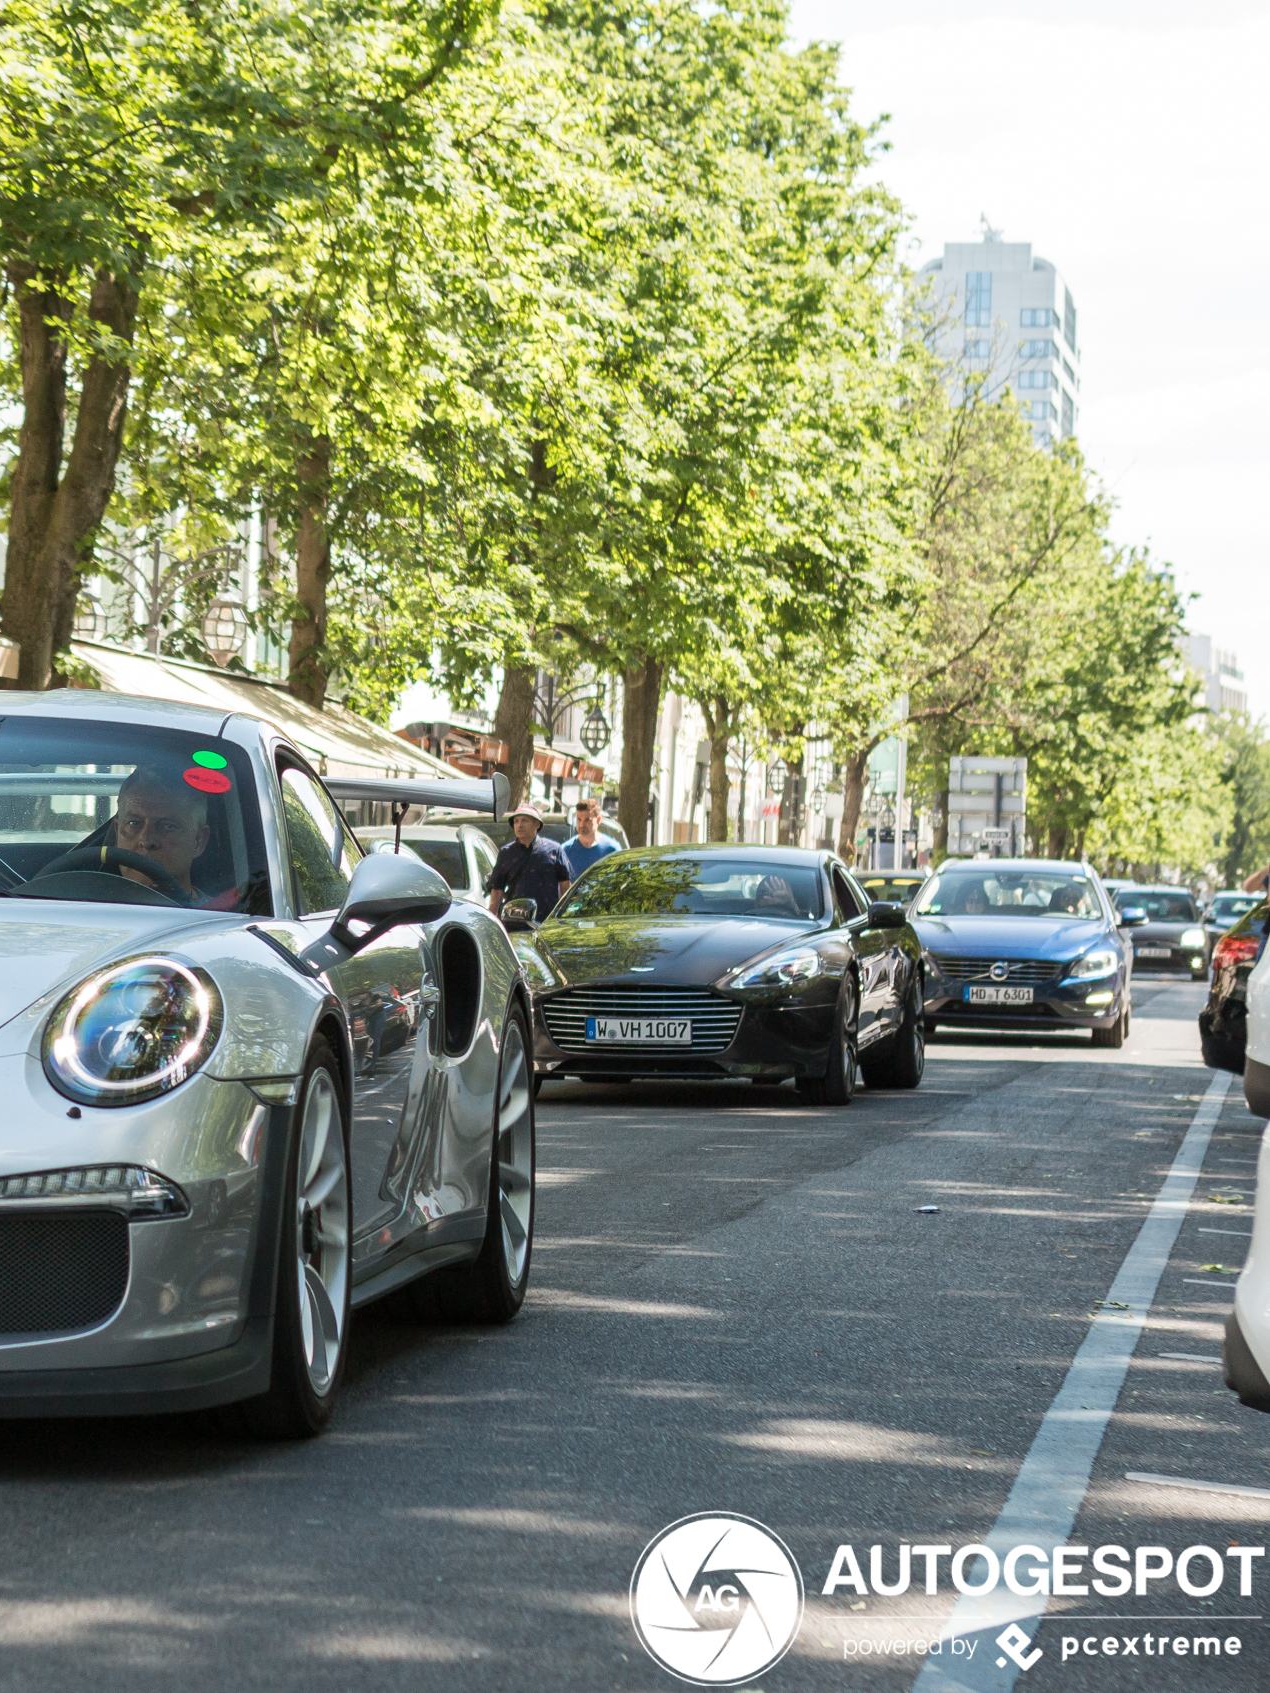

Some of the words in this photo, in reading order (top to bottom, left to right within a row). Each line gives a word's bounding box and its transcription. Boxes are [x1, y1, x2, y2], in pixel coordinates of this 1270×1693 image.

[971, 988, 986, 1000] HD
[994, 988, 1001, 1000] T
[1003, 988, 1032, 1000] 6301
[597, 1021, 607, 1037] W
[619, 1021, 641, 1038] VH
[645, 1022, 688, 1039] 1007
